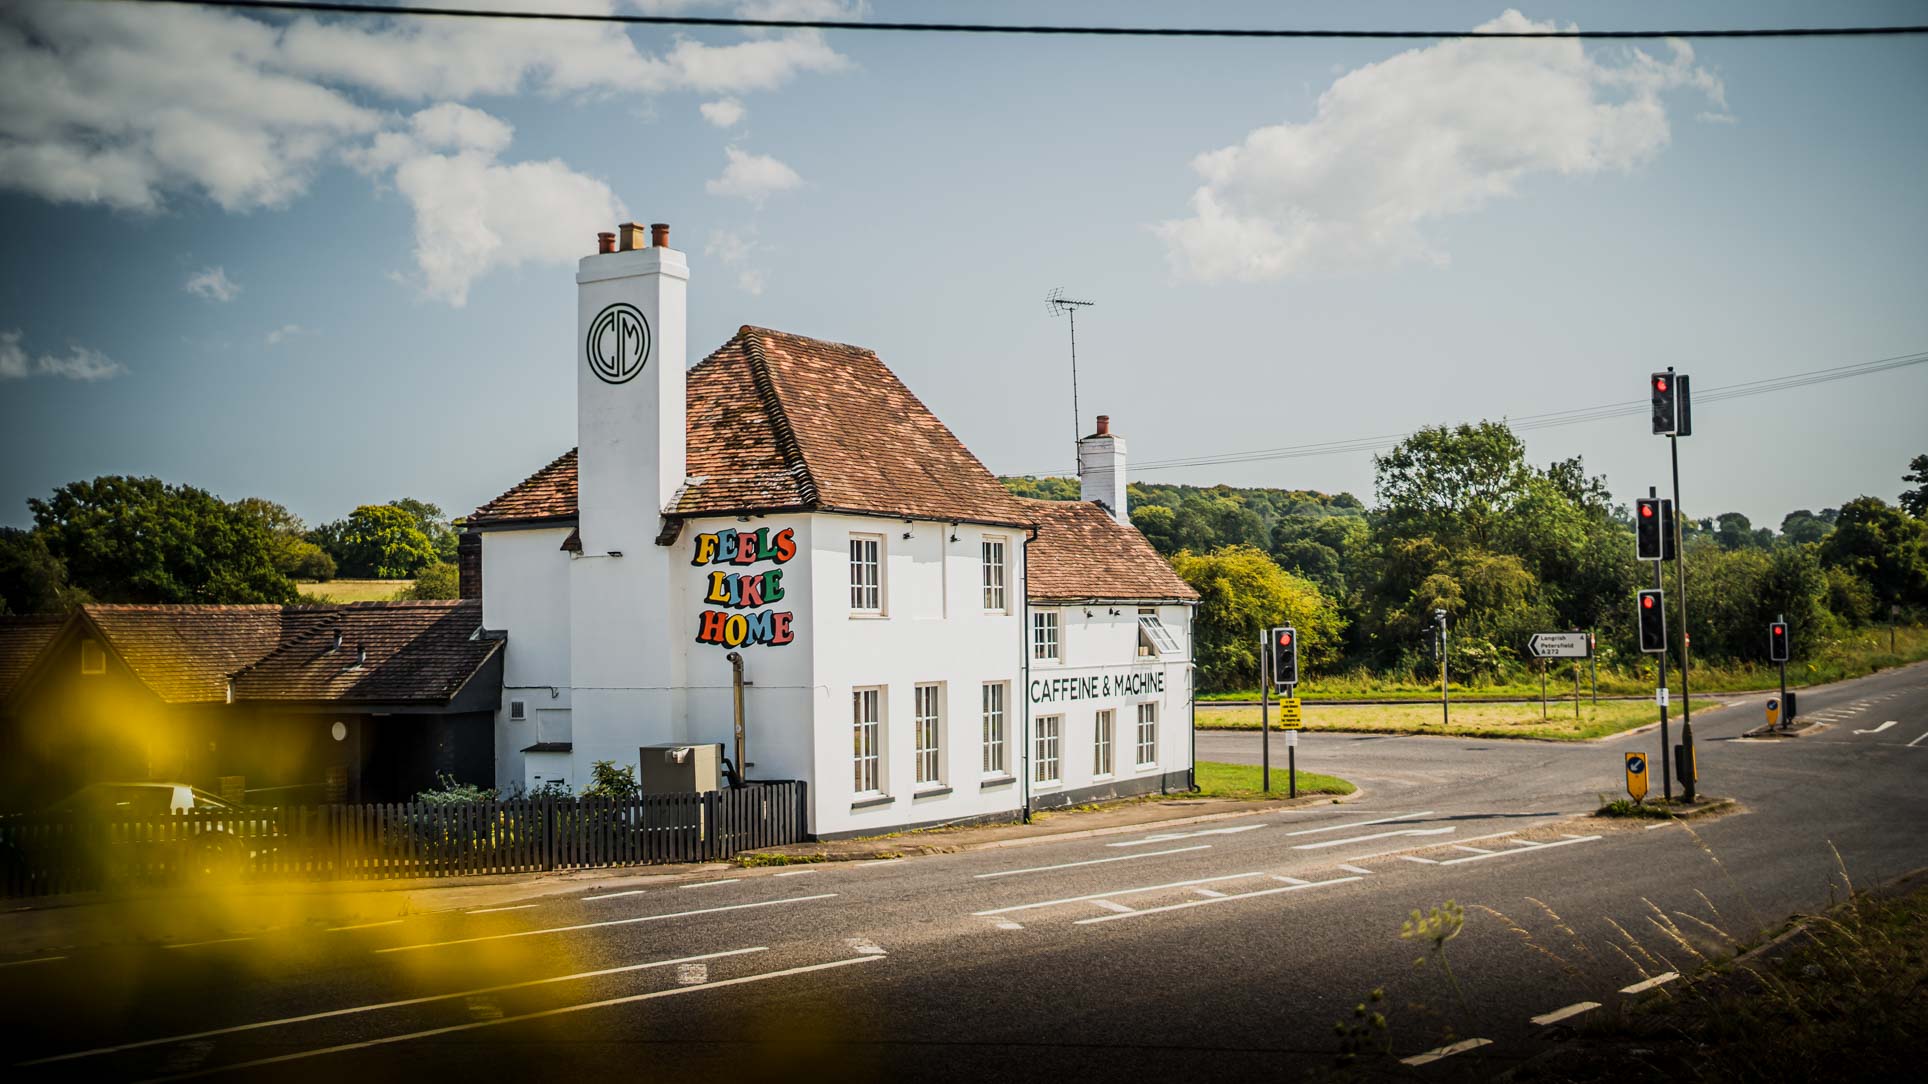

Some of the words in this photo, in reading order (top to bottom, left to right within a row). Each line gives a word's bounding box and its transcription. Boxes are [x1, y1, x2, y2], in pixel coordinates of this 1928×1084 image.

[691, 527, 797, 566] FEELS
[704, 568, 785, 609] LIKE
[696, 609, 794, 649] HOME
[1030, 676, 1099, 704] CAFFEINE
[1102, 675, 1111, 697] &
[1114, 671, 1164, 697] MACHINE
